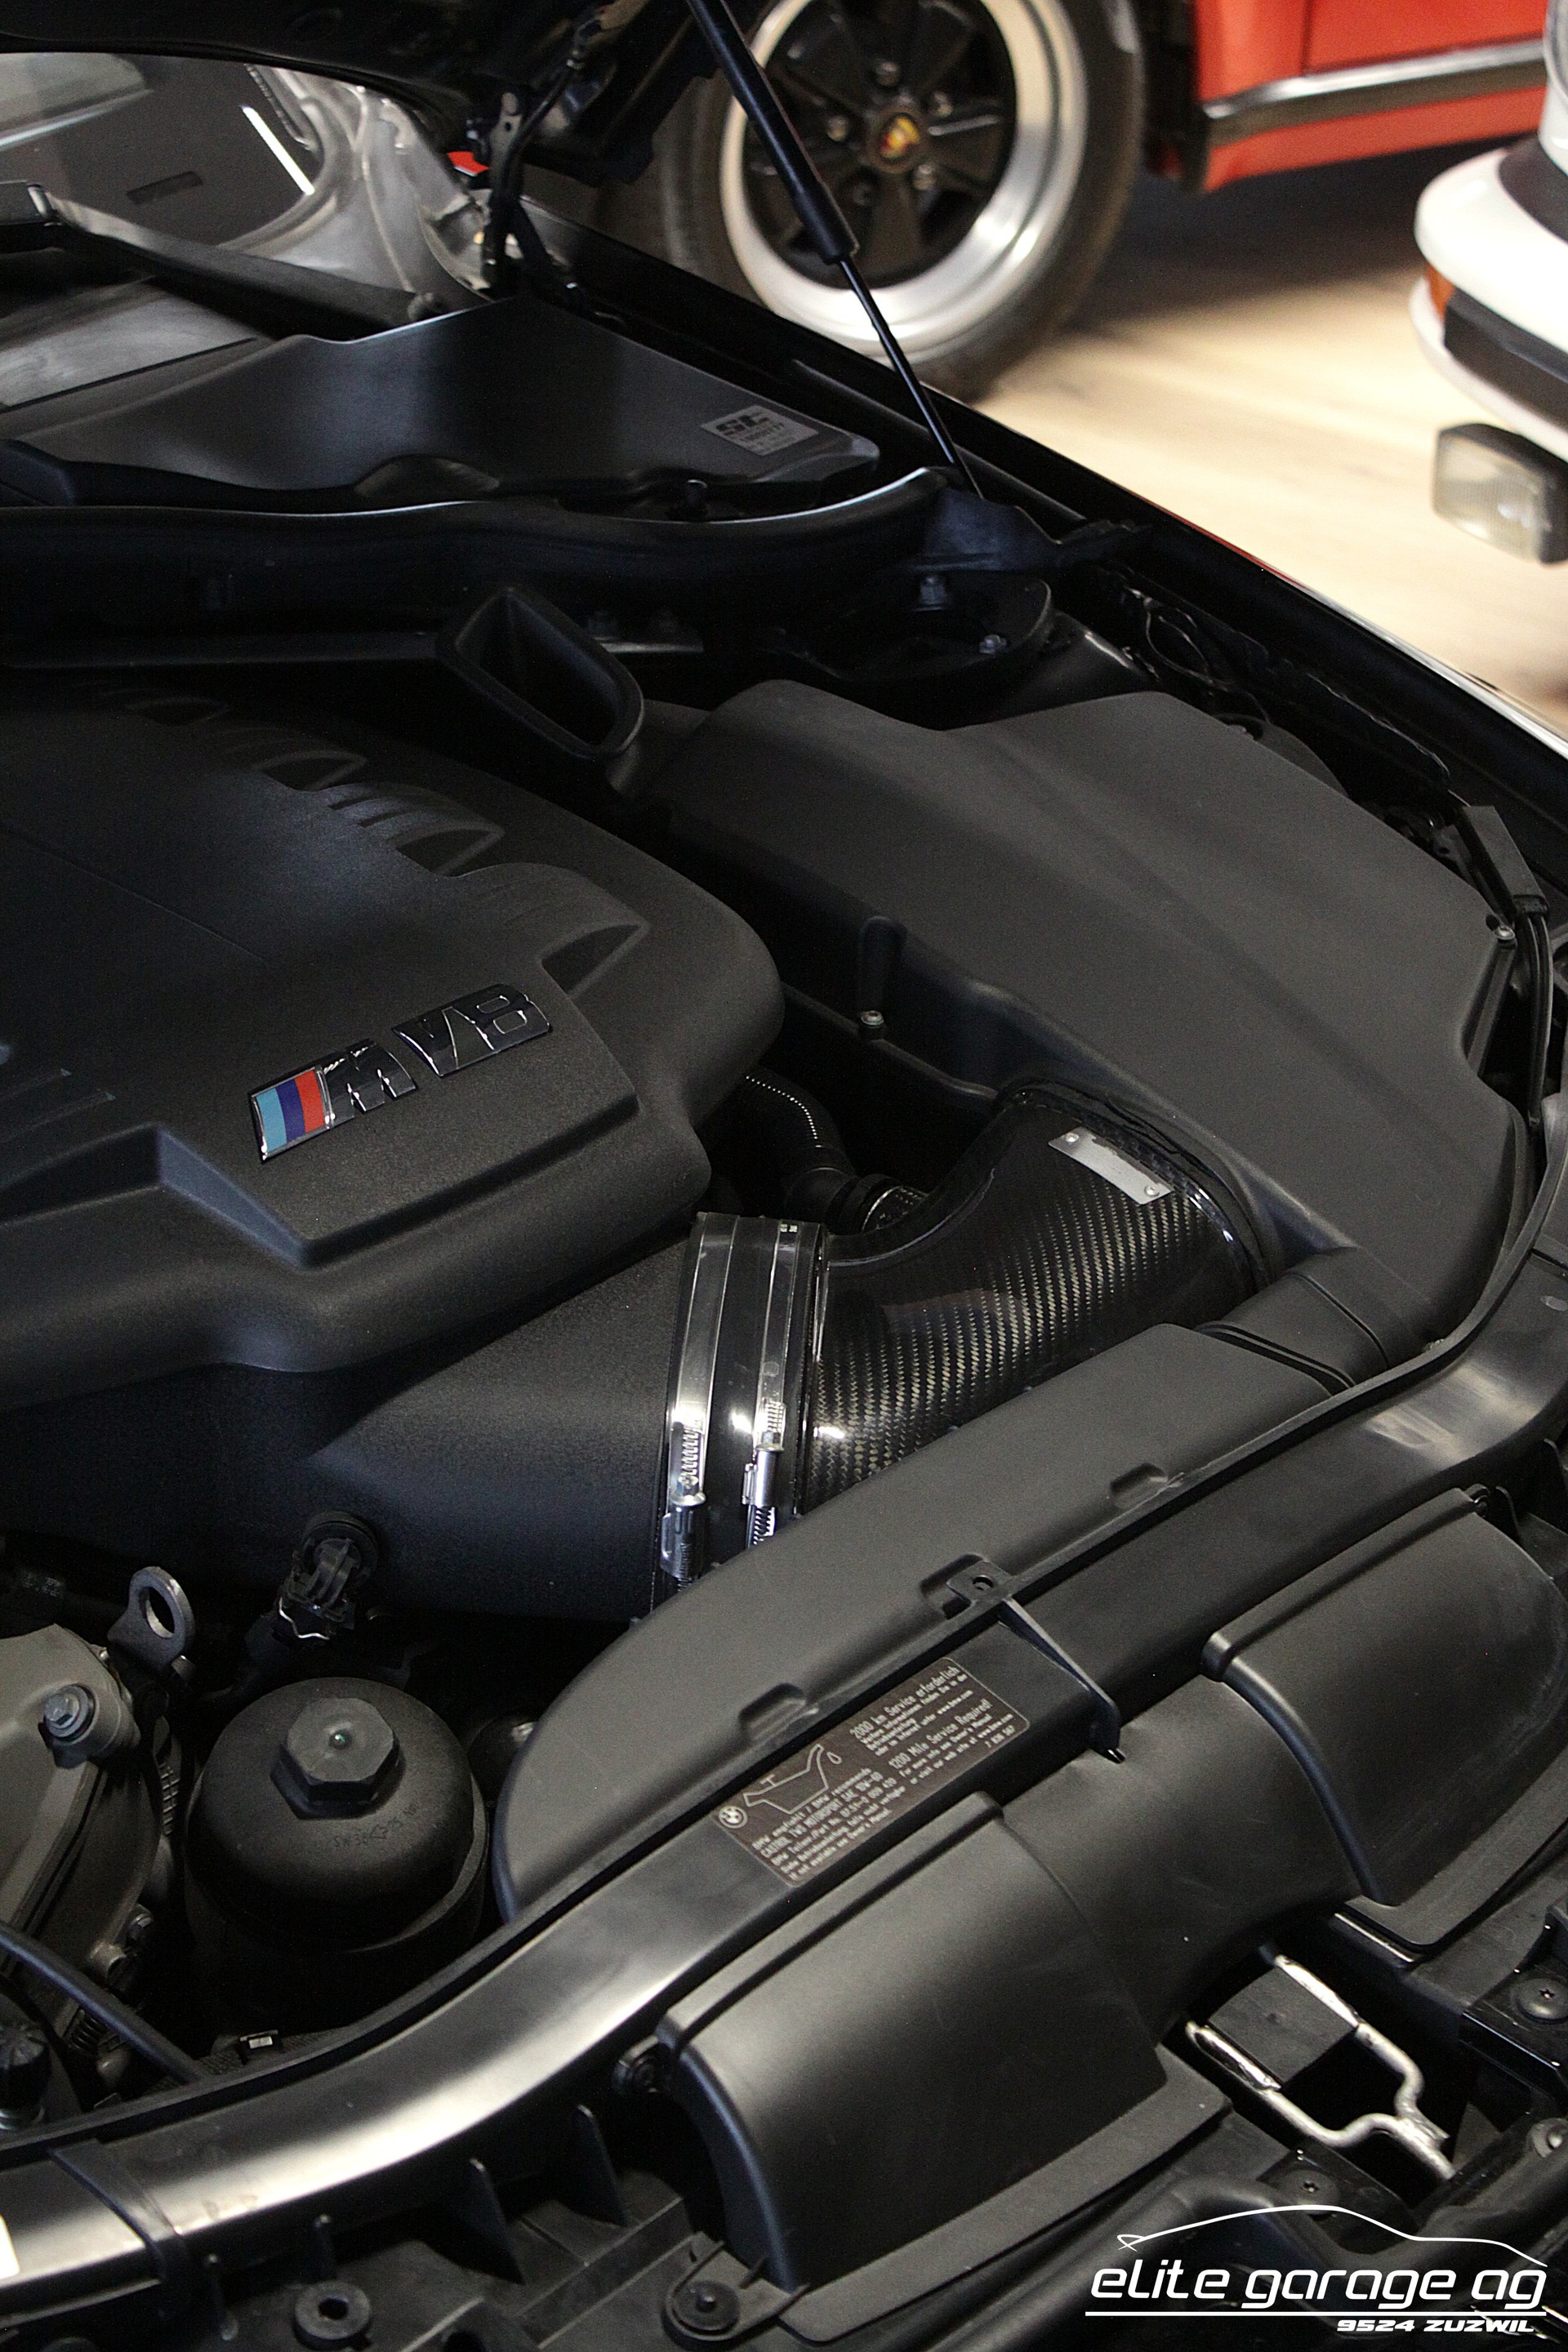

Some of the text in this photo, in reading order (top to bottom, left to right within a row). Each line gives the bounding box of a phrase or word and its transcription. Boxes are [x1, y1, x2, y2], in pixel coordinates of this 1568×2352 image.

[849, 1666, 960, 1739] 2000 km Service erforderlich
[889, 1699, 992, 1769] 1200 Mile Service Required!
[937, 1690, 973, 1714] www.bmw.com
[978, 1714, 1013, 1738] www.bmw.com
[752, 1836, 770, 1850] BMW
[812, 1795, 830, 1808] BMW
[831, 1768, 871, 1796] recommends
[760, 1771, 883, 1858] CASTROL TWS MOTORSPORT SAE 10W-60
[771, 1852, 789, 1866] BMW
